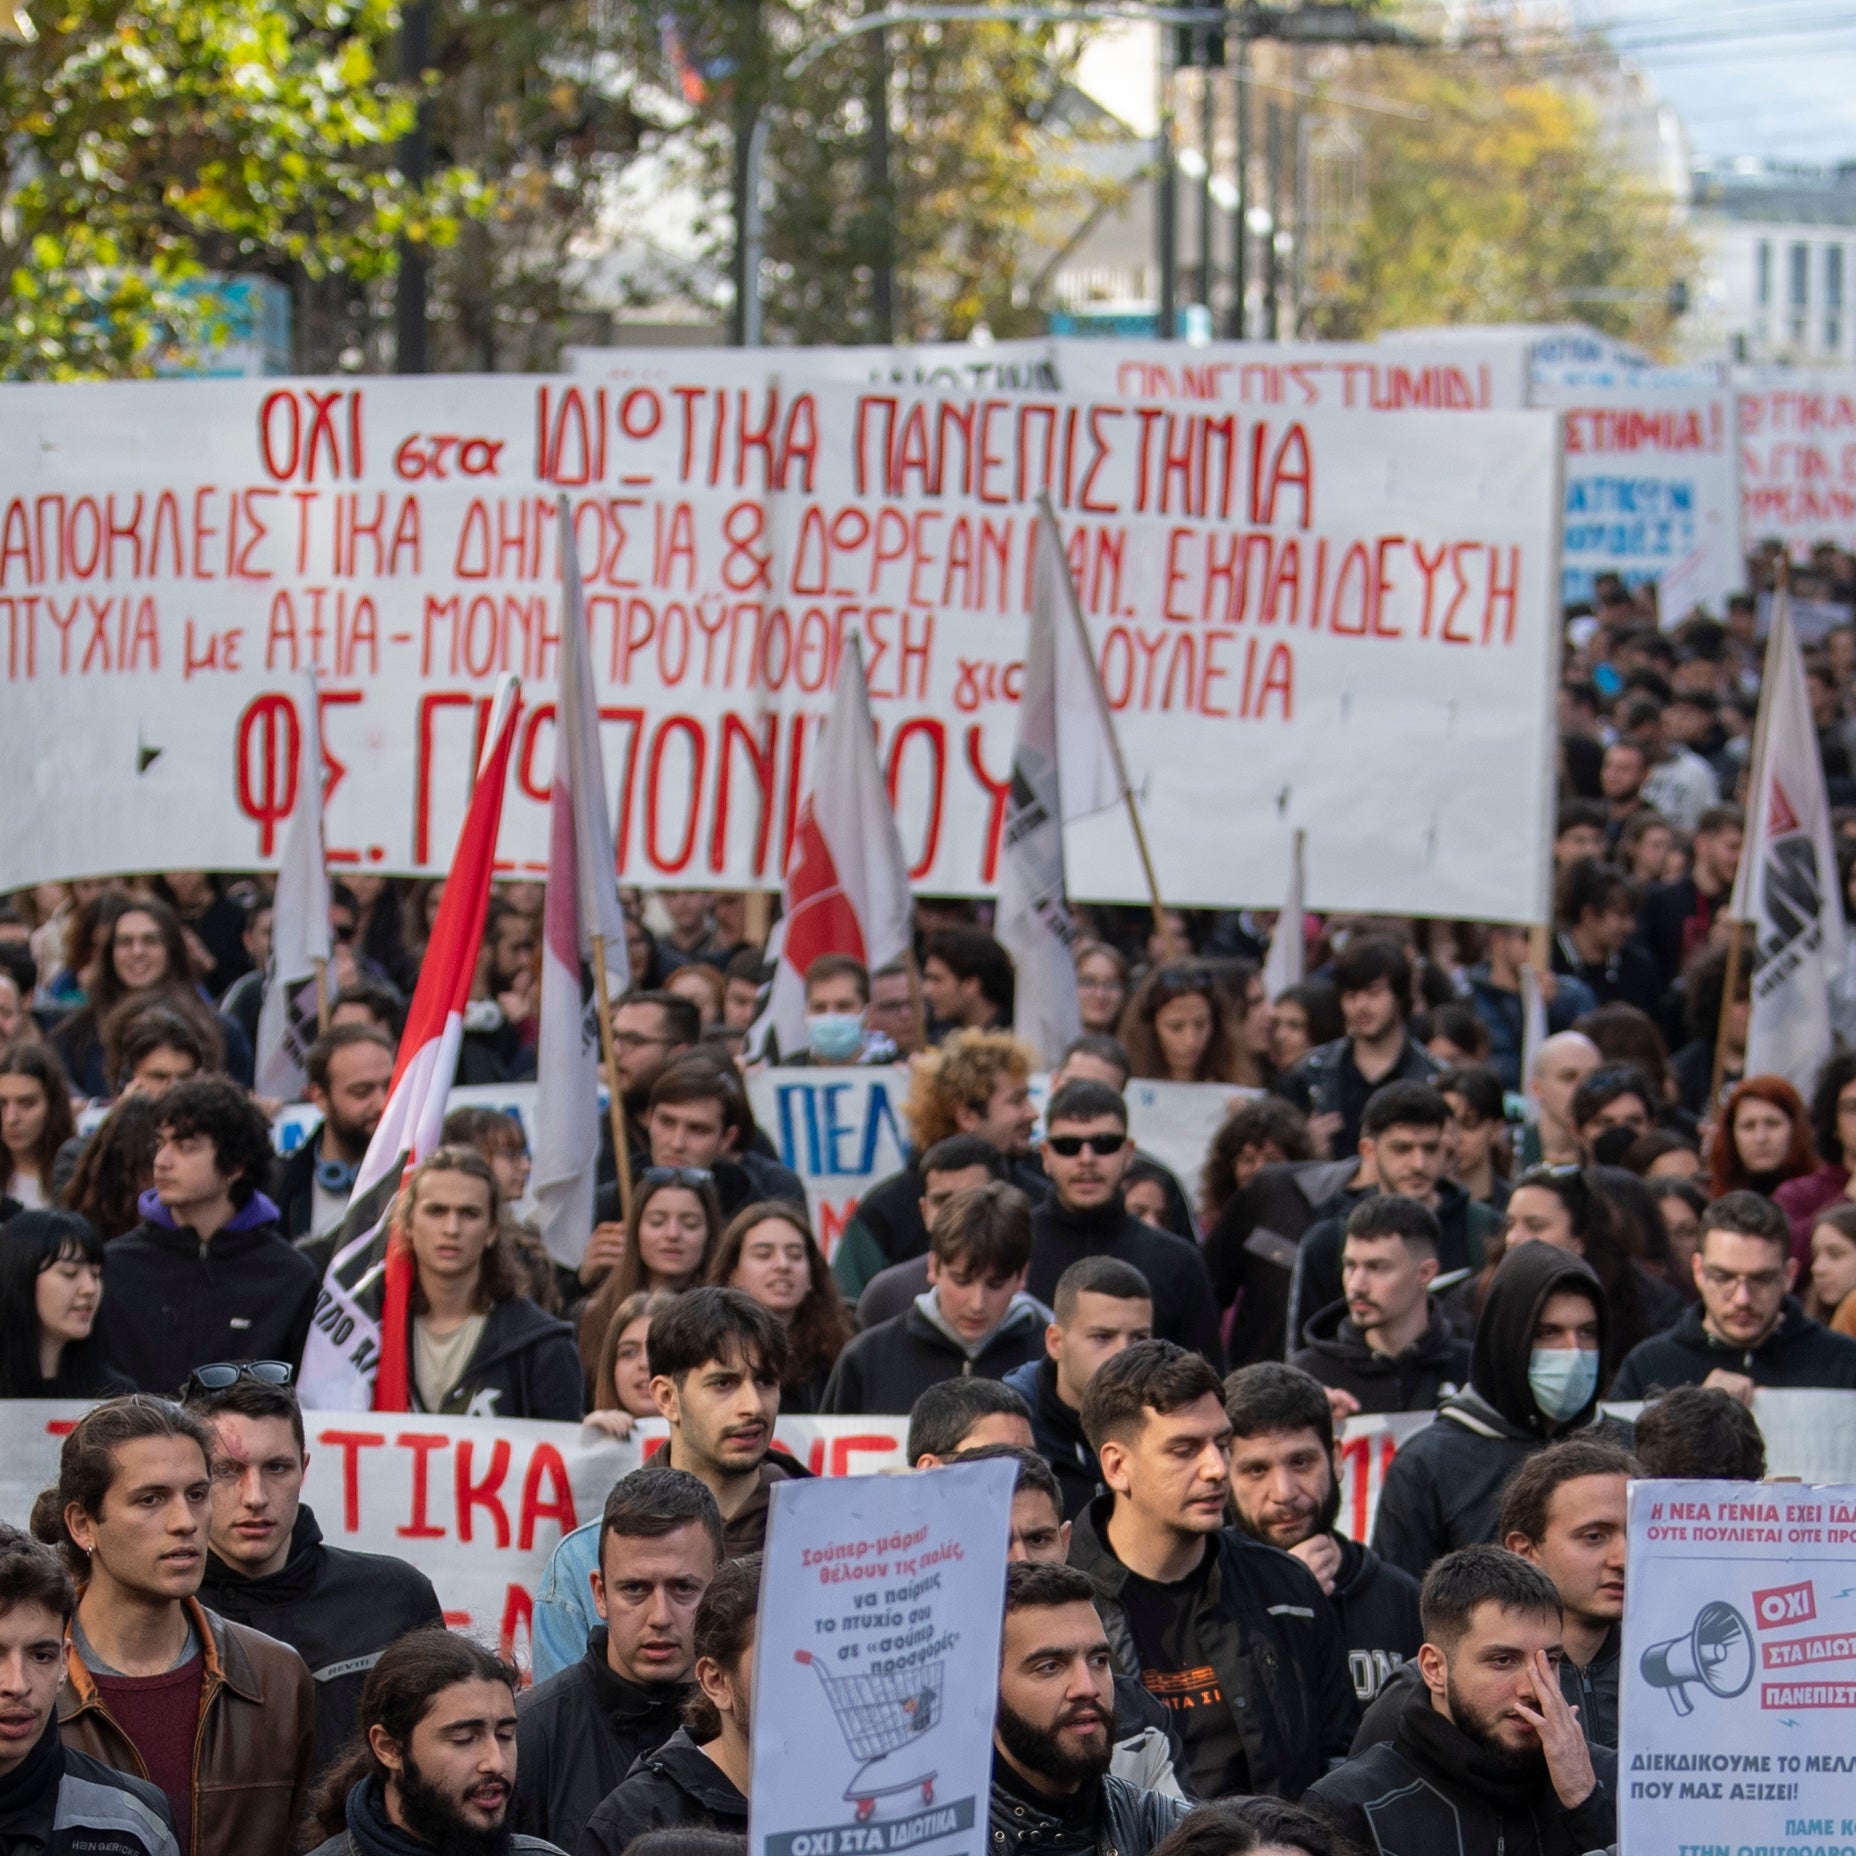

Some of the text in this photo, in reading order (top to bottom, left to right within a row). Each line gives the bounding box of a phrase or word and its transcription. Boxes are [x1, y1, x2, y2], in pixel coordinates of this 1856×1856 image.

[1565, 402, 1722, 453] ΣΤΗΜΙΑ!
[257, 383, 1316, 529] ΟΧΙ στα ΙΔΙΩΤΙΚΑ ΠΑΝΕΠΙΣΤΗΜΙΑ
[454, 491, 698, 591] ΔΗΜΟΣΙΑ
[721, 500, 773, 593] &
[790, 500, 1015, 616] ΔΩΡΕΑΝ
[1067, 526, 1137, 619] ΑΝ.
[1162, 526, 1521, 647] ΕΚΠΑΙΔΕΥΣΗ
[184, 616, 244, 680] με
[264, 587, 379, 677] ΑΞΙΑ
[421, 595, 560, 681] ΜΟΝΗ
[1100, 625, 1296, 723] ΟΥΛΕΙΑ
[1650, 1504, 1666, 1523] Η
[1670, 1503, 1712, 1522] ΝΕΑ
[1716, 1503, 1780, 1524] ΓΕΝΙΑ
[1786, 1504, 1822, 1524] ΕΧΕΙ
[1647, 1525, 1687, 1542] ΟΥΤΕ
[1692, 1526, 1782, 1543] ΠΟΥΛΙΕΤΑΙ
[1787, 1527, 1822, 1544] ΟΥΤΕ
[819, 1563, 888, 1584] θέλουν
[895, 1558, 917, 1576] τις
[853, 1592, 877, 1609] να
[1760, 1586, 1810, 1623] ΟΧΙ
[815, 1604, 931, 1633] το πτυχίο σου
[838, 1643, 859, 1660] σε
[1768, 1643, 1803, 1666] ΣΤΑ
[1631, 1753, 1772, 1774] ΔΙΕΚΔΙΚΟΥΜΕ
[1777, 1754, 1802, 1774] ΤΟ
[1631, 1781, 1799, 1802] ΠΟΥ ΜΑΣ ΑΞΙΖΕΙ!
[1786, 1819, 1835, 1836] ΠΑΜΕ
[839, 1827, 885, 1853] ΣΤΑ
